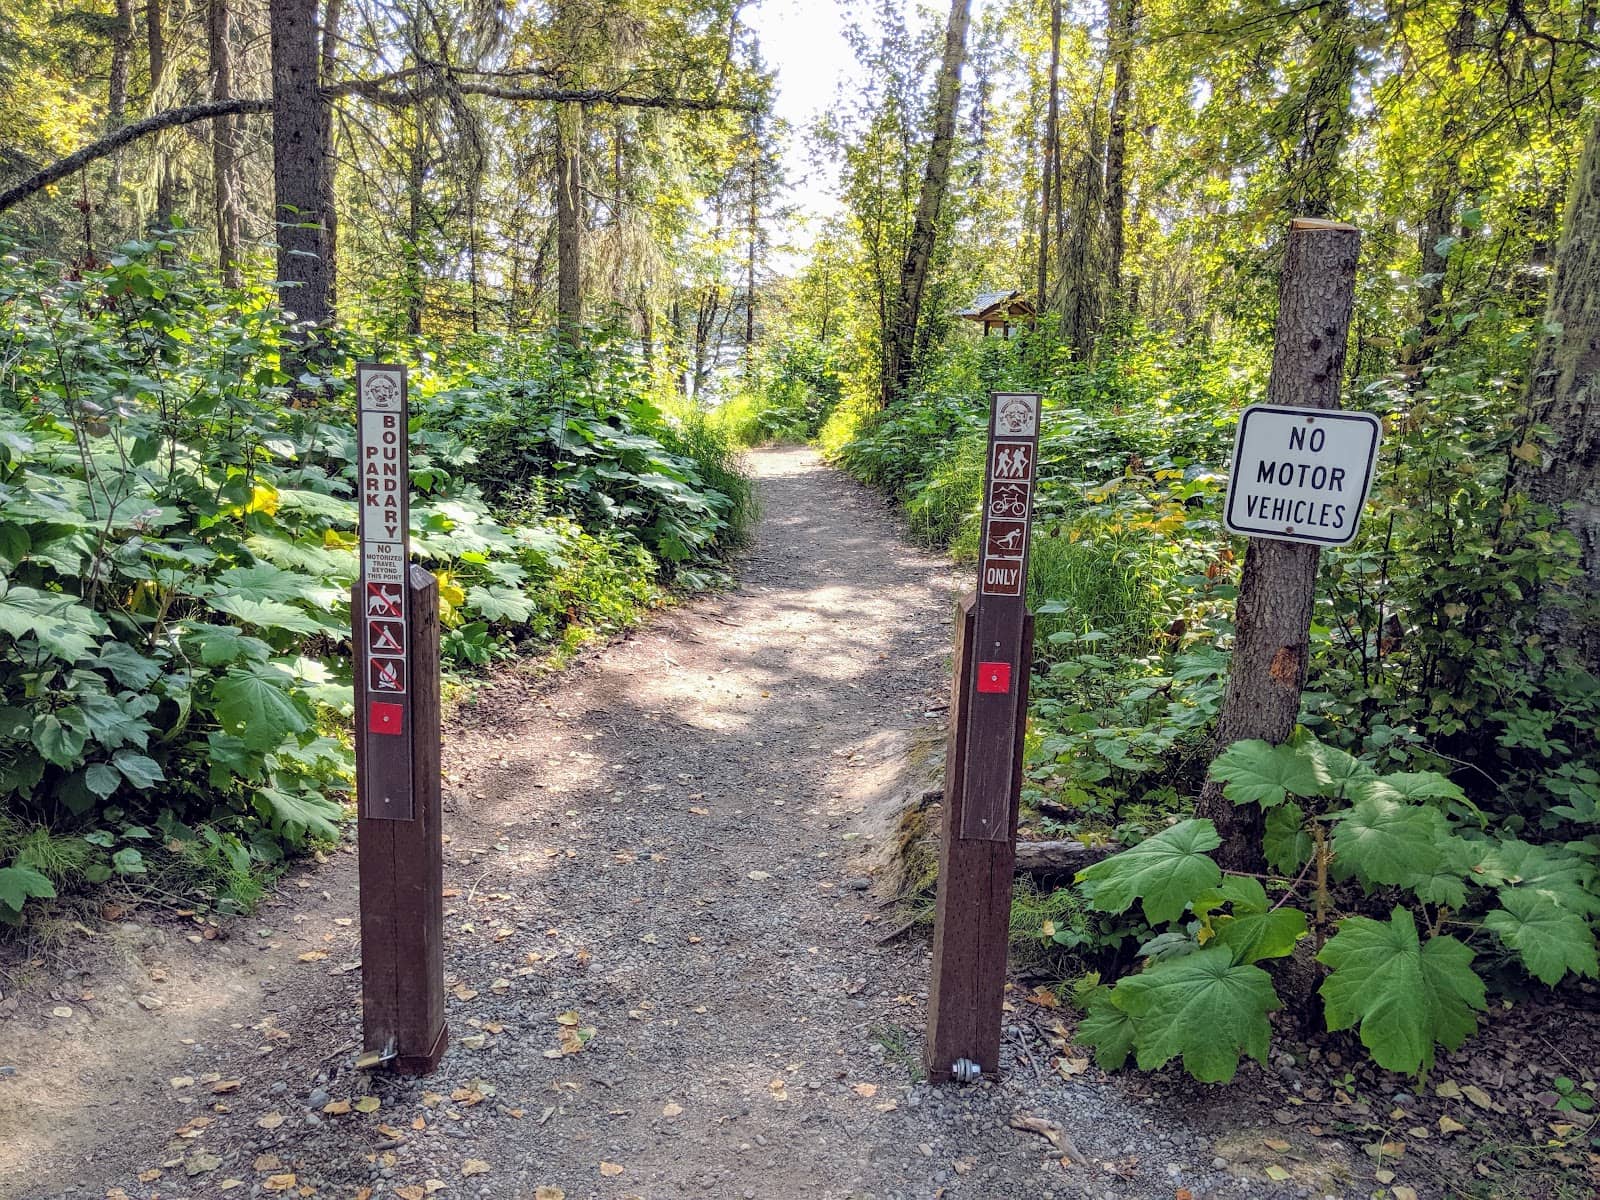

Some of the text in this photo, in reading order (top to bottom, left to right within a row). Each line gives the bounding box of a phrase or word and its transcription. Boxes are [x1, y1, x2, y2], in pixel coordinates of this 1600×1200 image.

[1289, 426, 1326, 453] NO
[366, 446, 380, 507] PARK
[382, 415, 398, 539] BOUNDARY
[1256, 460, 1346, 492] MOTOR
[1247, 494, 1346, 529] VEHICLES
[366, 553, 403, 562] MOTORIZED
[377, 544, 392, 554] NO
[987, 567, 1018, 586] ONLY
